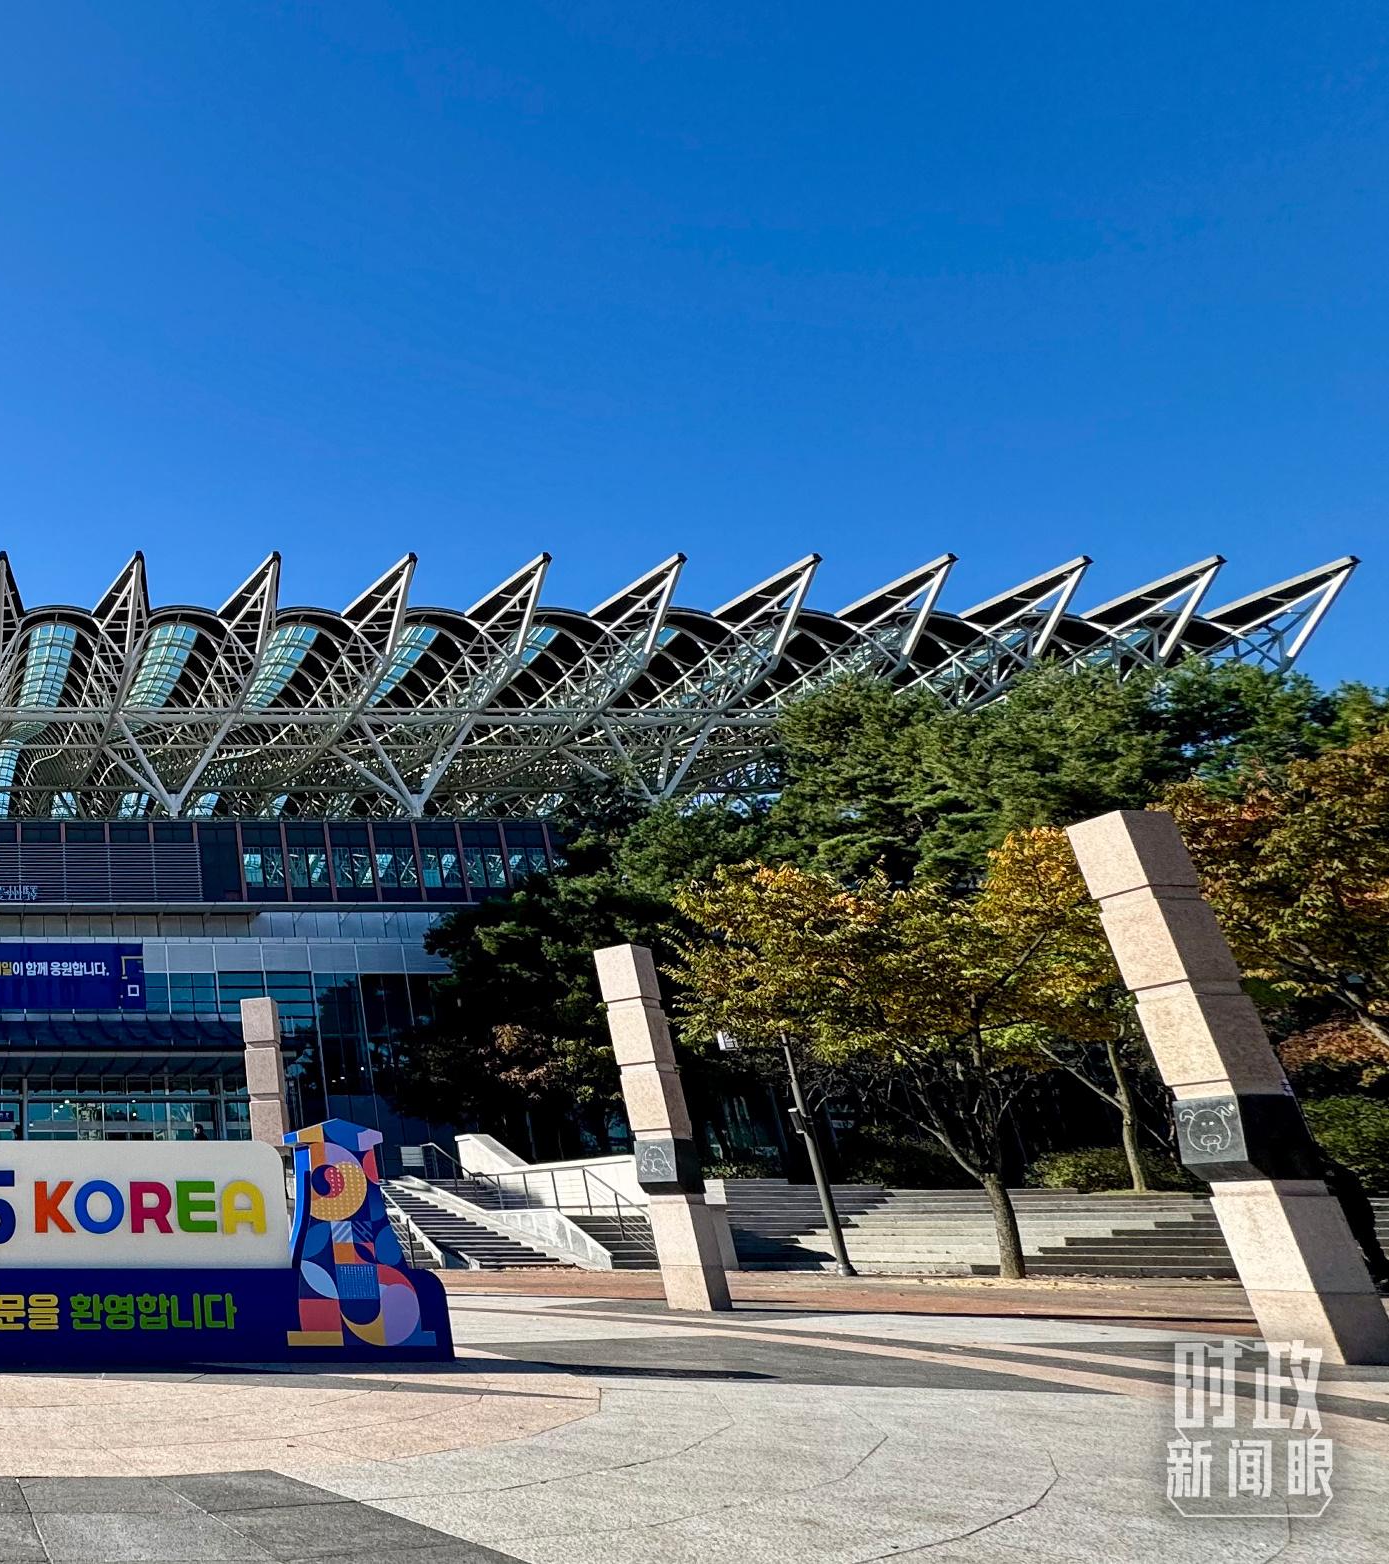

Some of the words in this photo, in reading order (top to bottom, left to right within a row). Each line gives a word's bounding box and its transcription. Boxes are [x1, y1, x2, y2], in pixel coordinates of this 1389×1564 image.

[25, 961, 49, 977] 함께
[50, 961, 110, 977] 응원합니다.
[35, 1180, 267, 1235] KOREA
[70, 1292, 237, 1330] 환영합니다
